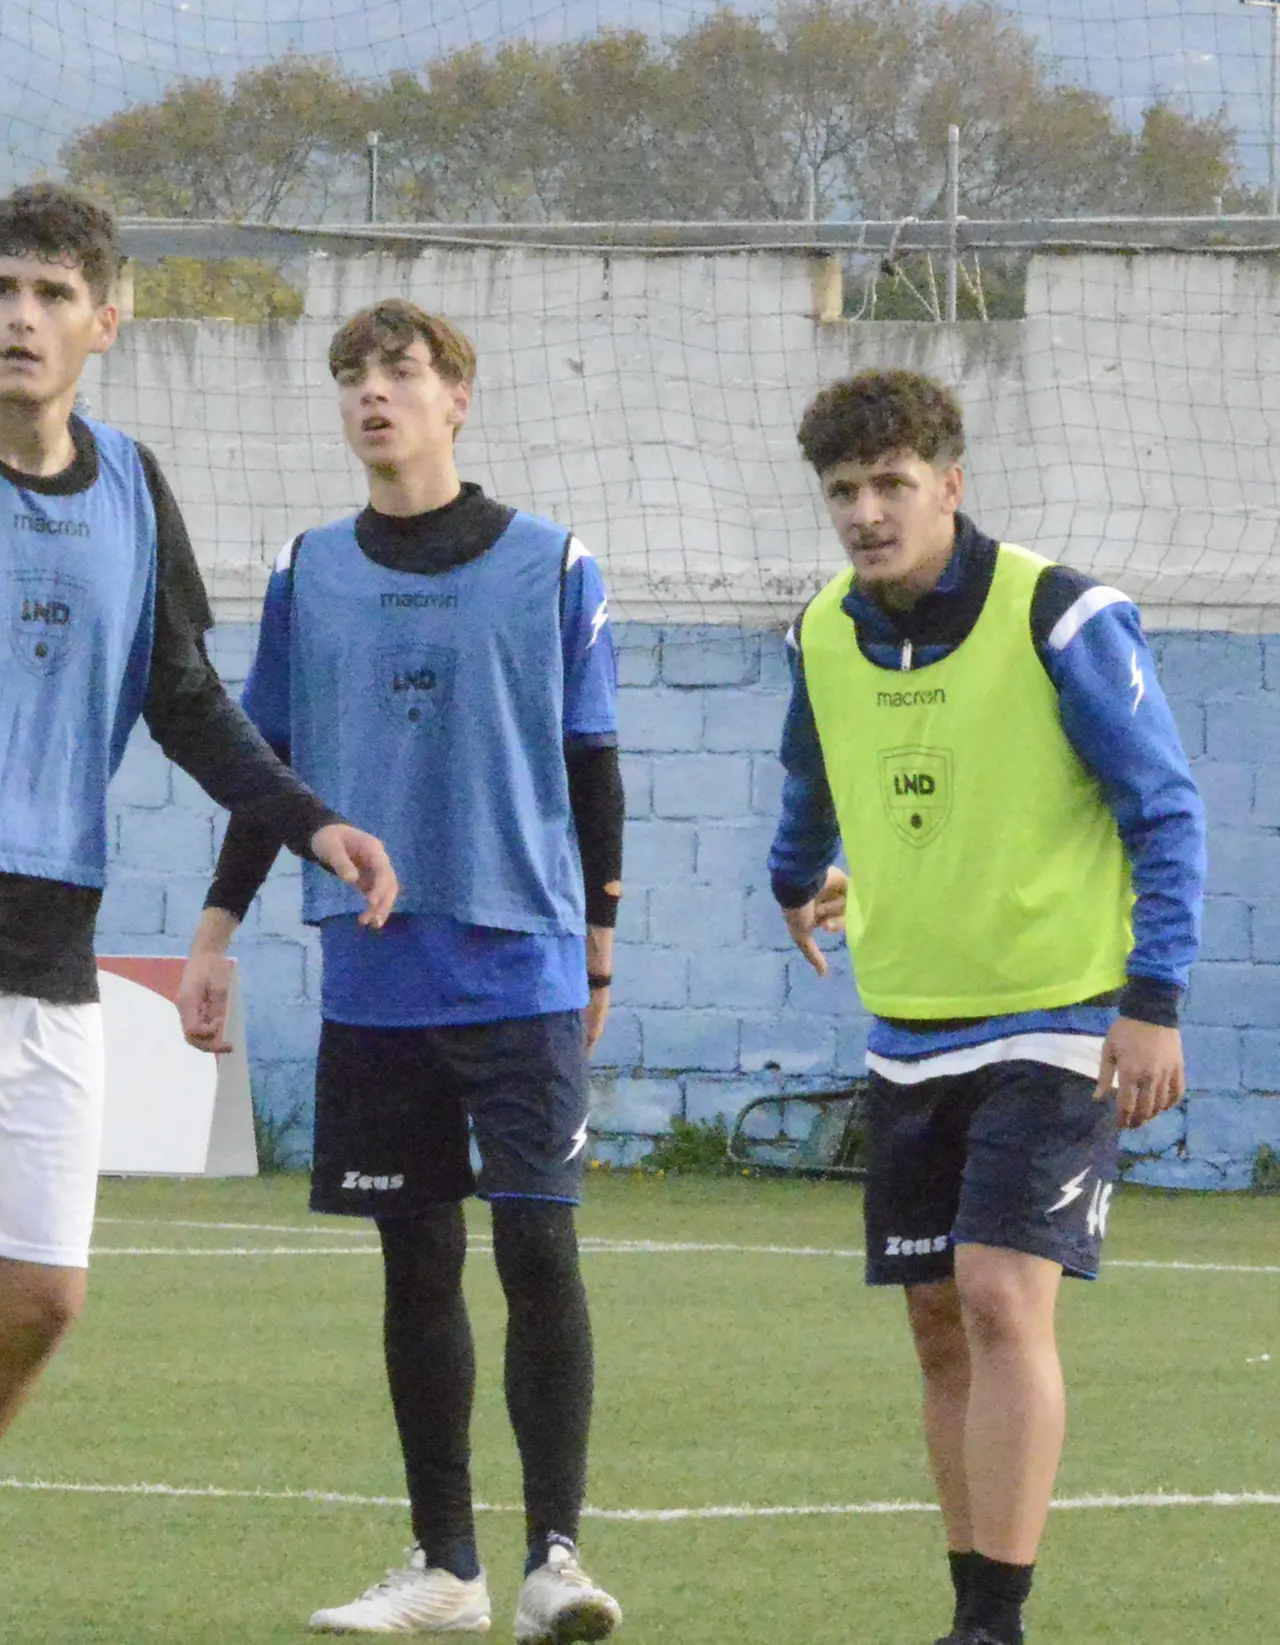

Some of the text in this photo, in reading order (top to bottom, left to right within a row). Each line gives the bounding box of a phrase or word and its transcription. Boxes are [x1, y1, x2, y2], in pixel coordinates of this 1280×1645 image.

[876, 688, 946, 708] macron
[894, 773, 936, 797] LND
[341, 1171, 405, 1190] Zeus
[884, 1235, 948, 1256] Zeus
